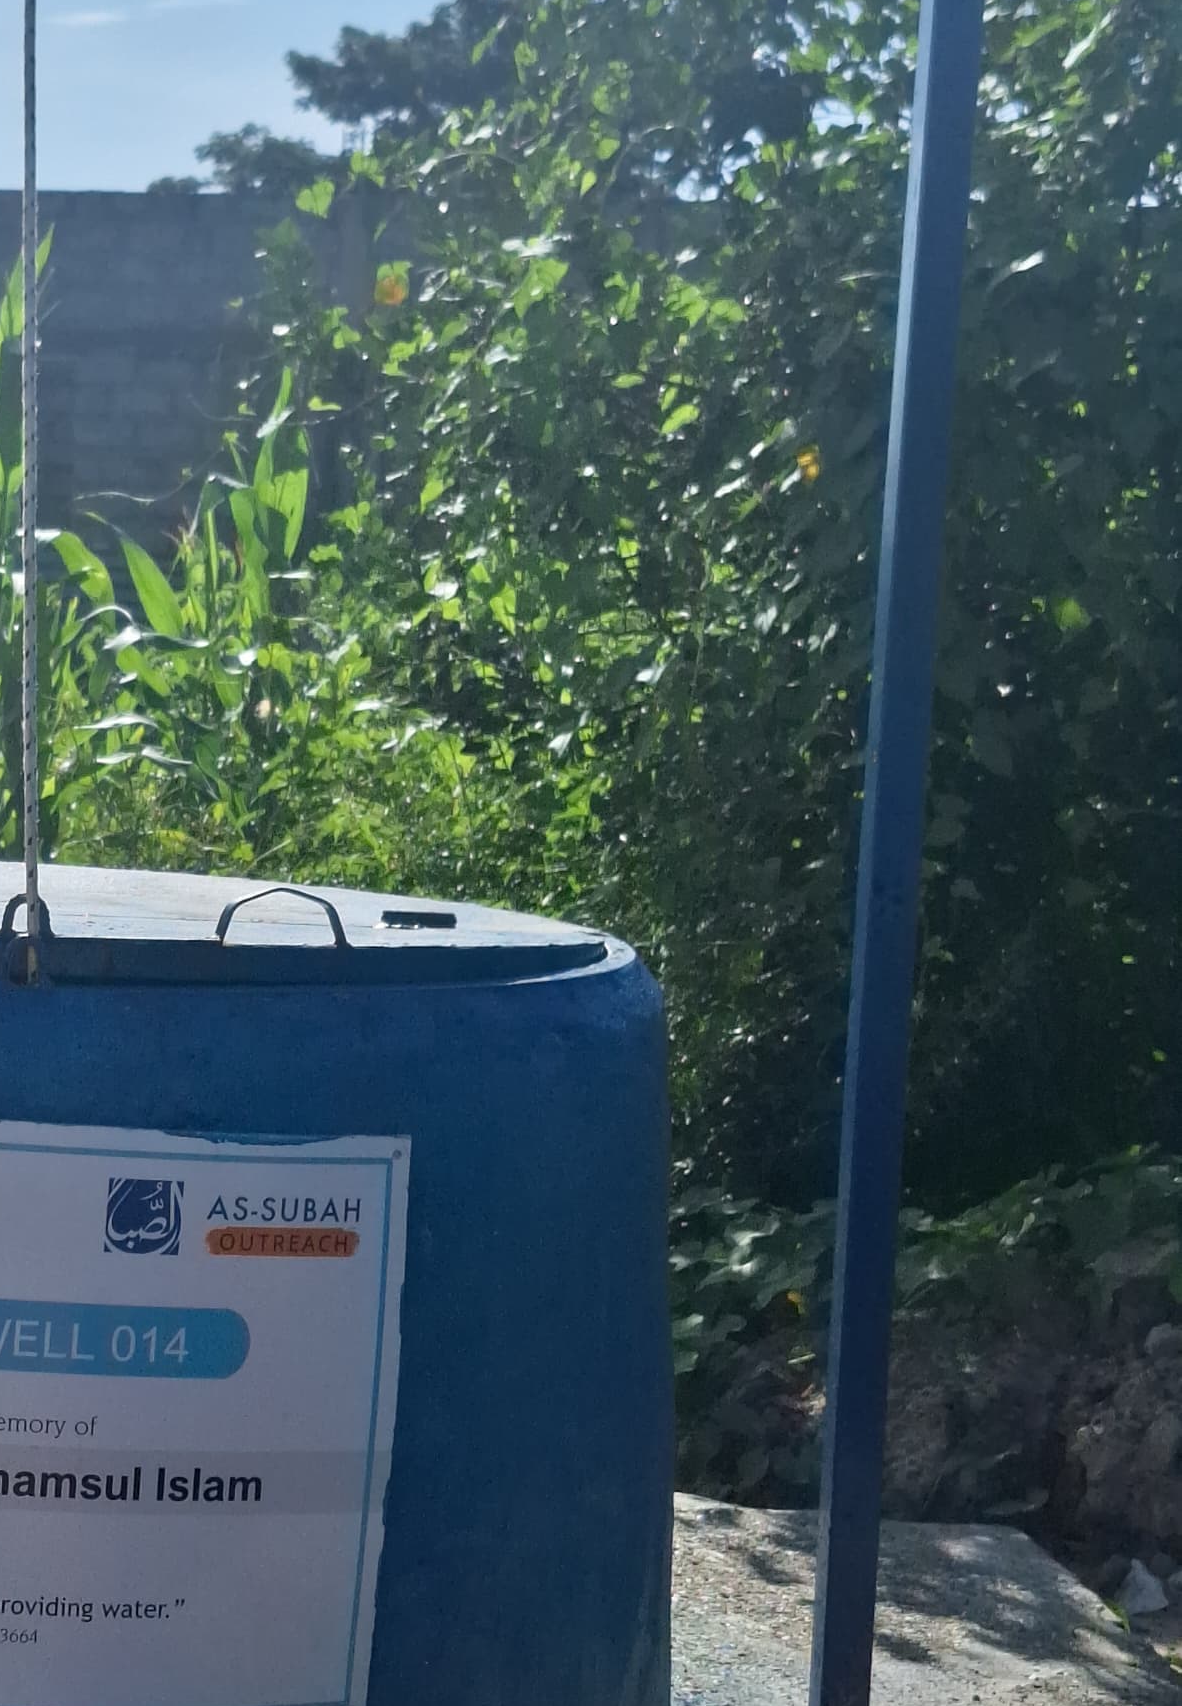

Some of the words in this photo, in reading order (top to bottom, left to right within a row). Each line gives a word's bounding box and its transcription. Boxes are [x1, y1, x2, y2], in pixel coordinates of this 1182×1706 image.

[207, 1194, 361, 1223] AS-SUBAH
[219, 1232, 348, 1255] OUTREACH
[111, 1325, 189, 1364] 014
[74, 1415, 98, 1437] of
[156, 1467, 263, 1503] Islam
[0, 1628, 39, 1644] 3664
